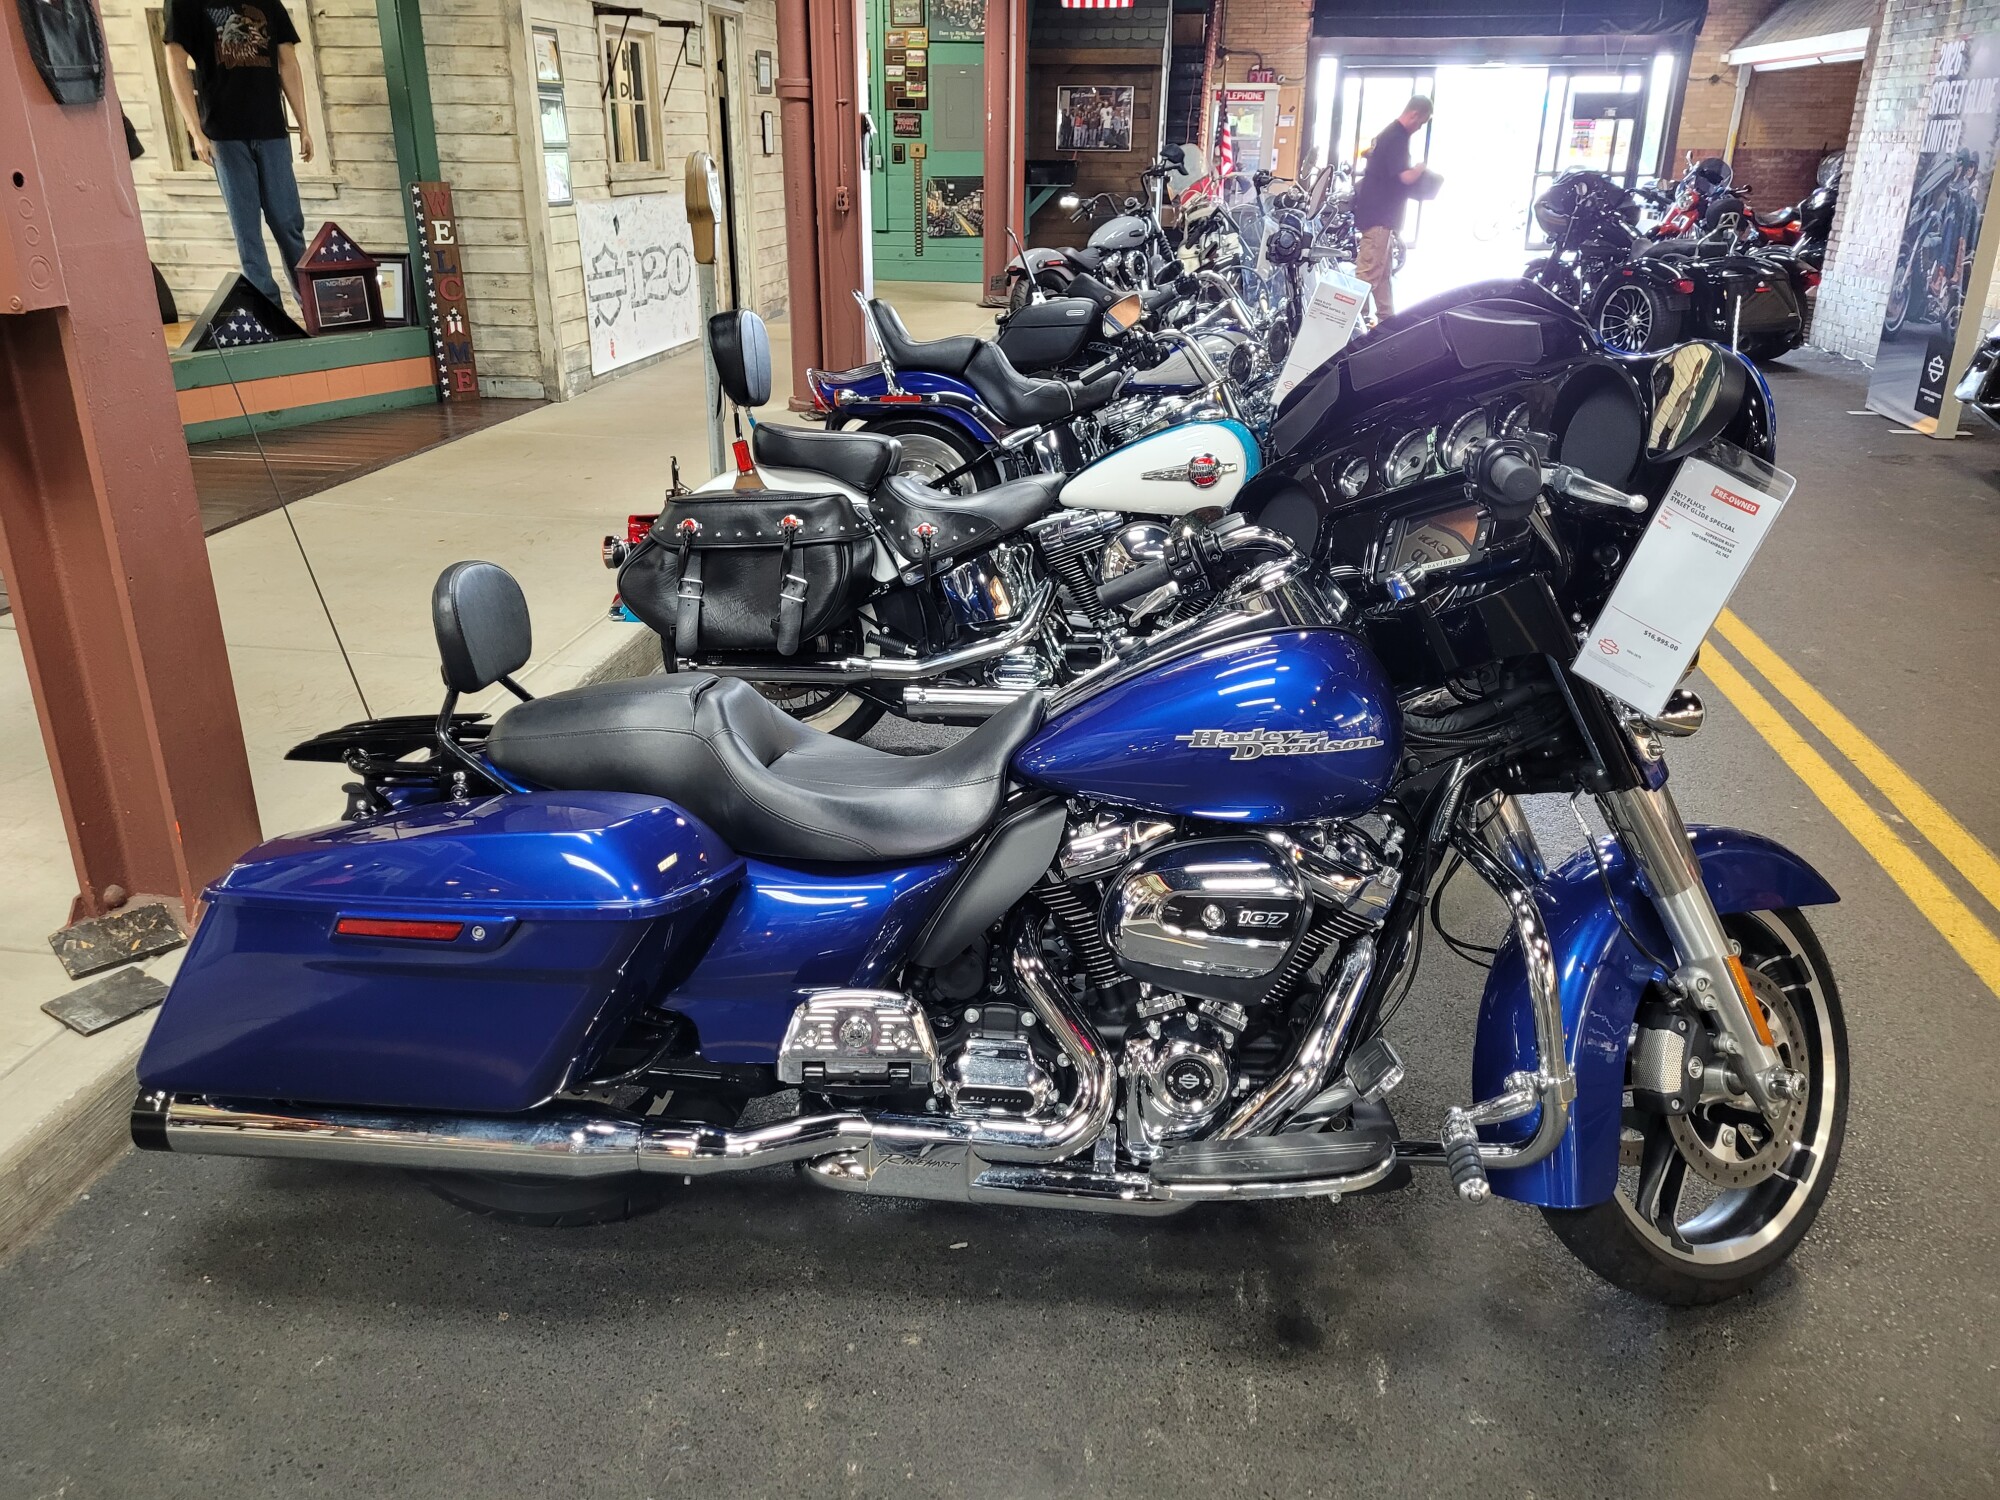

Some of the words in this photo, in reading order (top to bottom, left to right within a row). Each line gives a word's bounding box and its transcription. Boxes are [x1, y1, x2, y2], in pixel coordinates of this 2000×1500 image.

[1936, 41, 1965, 76] 2026
[1249, 70, 1273, 83] EXIT
[1217, 91, 1264, 100] TLEPHONE
[1929, 80, 1968, 114] STREET
[1964, 78, 1999, 114] GLIDE
[1920, 119, 1962, 153] LIMITED
[627, 242, 692, 309] 120
[423, 191, 475, 392] WELCME
[1673, 490, 1687, 501] 2017
[1686, 497, 1707, 511] FLHXS
[1713, 488, 1757, 512] PRE-OWNED
[1670, 496, 1691, 510] STREET
[1690, 508, 1709, 520] GLIDE
[1709, 517, 1735, 533] SPECIAL
[1643, 630, 1679, 652] $16,995.00
[1176, 728, 1316, 748] Harley
[1230, 737, 1384, 760] Davidson
[1238, 910, 1289, 925] 107
[878, 1153, 961, 1170] RINEHART
